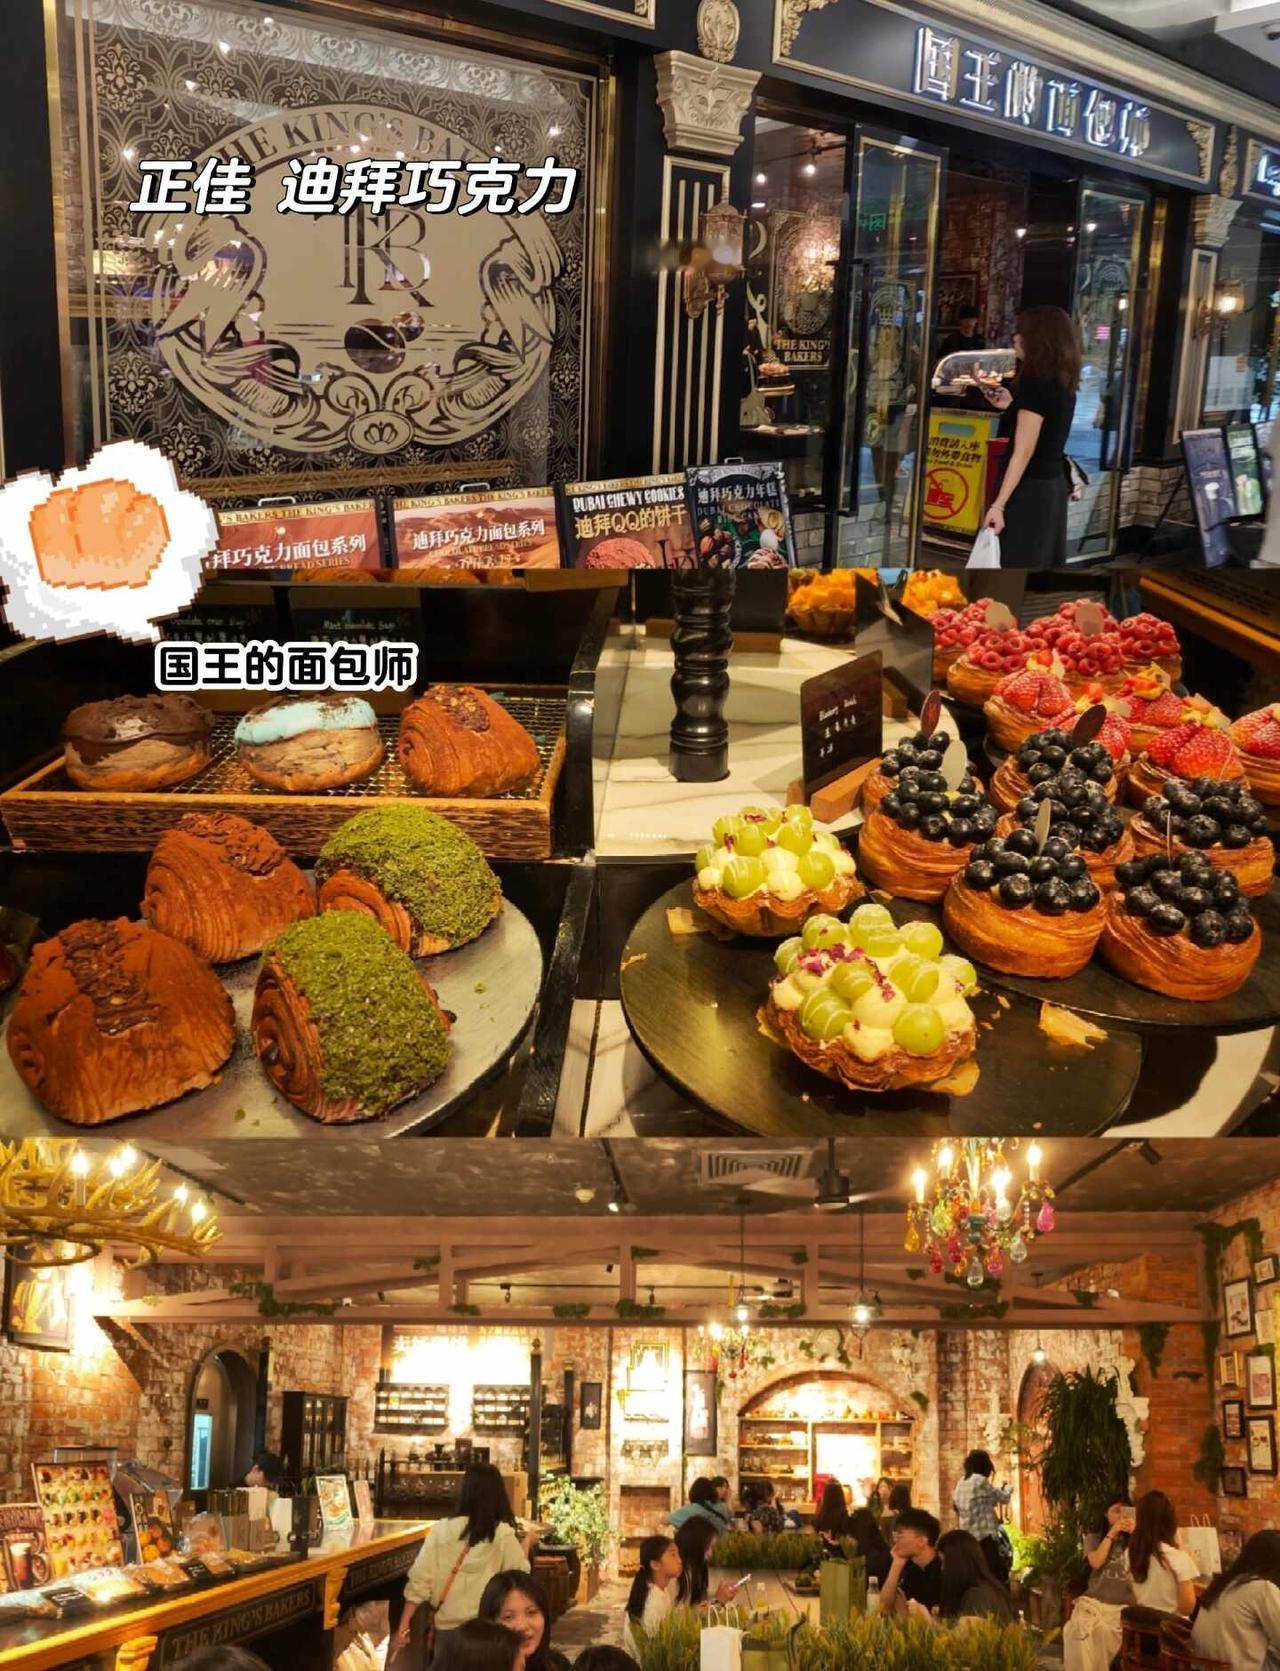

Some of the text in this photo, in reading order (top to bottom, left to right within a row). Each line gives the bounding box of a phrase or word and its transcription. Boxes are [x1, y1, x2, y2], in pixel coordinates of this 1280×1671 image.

[914, 27, 1151, 158] 国王的面包师
[206, 127, 277, 165] HE
[280, 111, 404, 149] KING'S
[784, 351, 822, 362] BAKERS
[281, 509, 302, 520] THE
[573, 486, 685, 513] DUBAI CHEWY COOKIES
[412, 518, 545, 551] 迪拜巧克力面包系列
[574, 503, 688, 540] 迪拜QQ的饼干
[206, 534, 366, 569] 拜巧克力面包系列
[317, 557, 352, 569] SERIES
[264, 1590, 313, 1622] BAKERS
